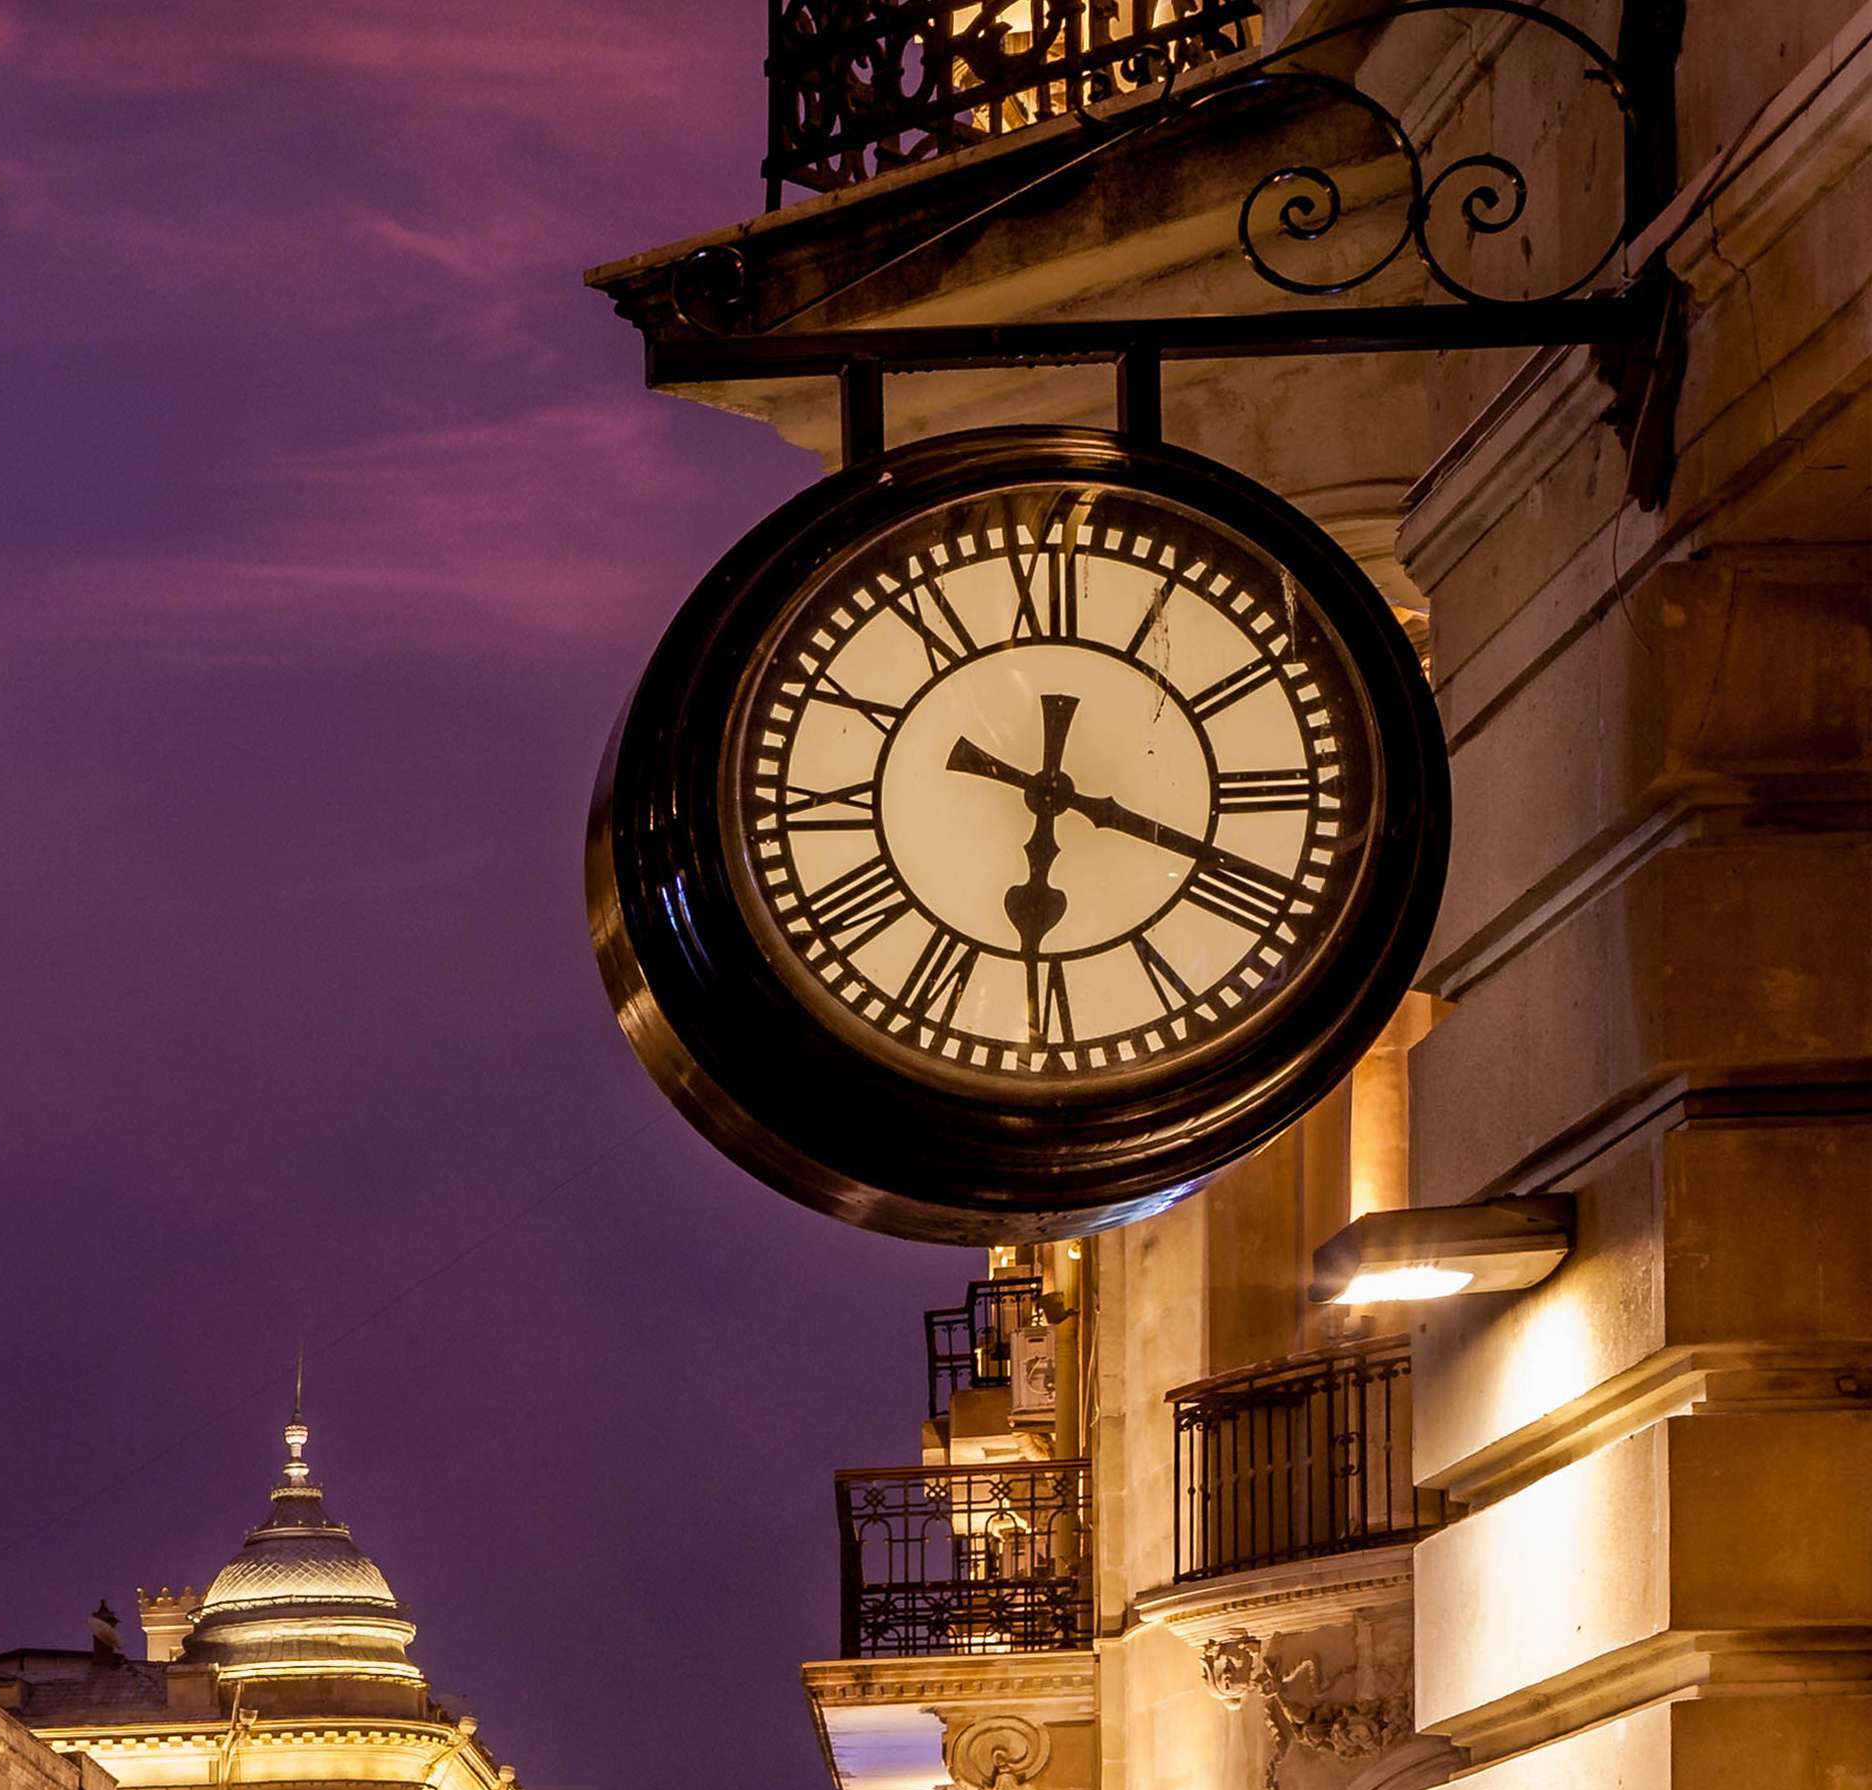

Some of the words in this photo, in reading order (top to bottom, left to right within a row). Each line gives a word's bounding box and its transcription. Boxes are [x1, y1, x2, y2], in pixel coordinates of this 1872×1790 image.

[887, 575, 980, 677] XI
[1007, 552, 1079, 641] XII
[807, 668, 906, 737] X
[1185, 653, 1280, 723] II
[1215, 768, 1310, 815] III
